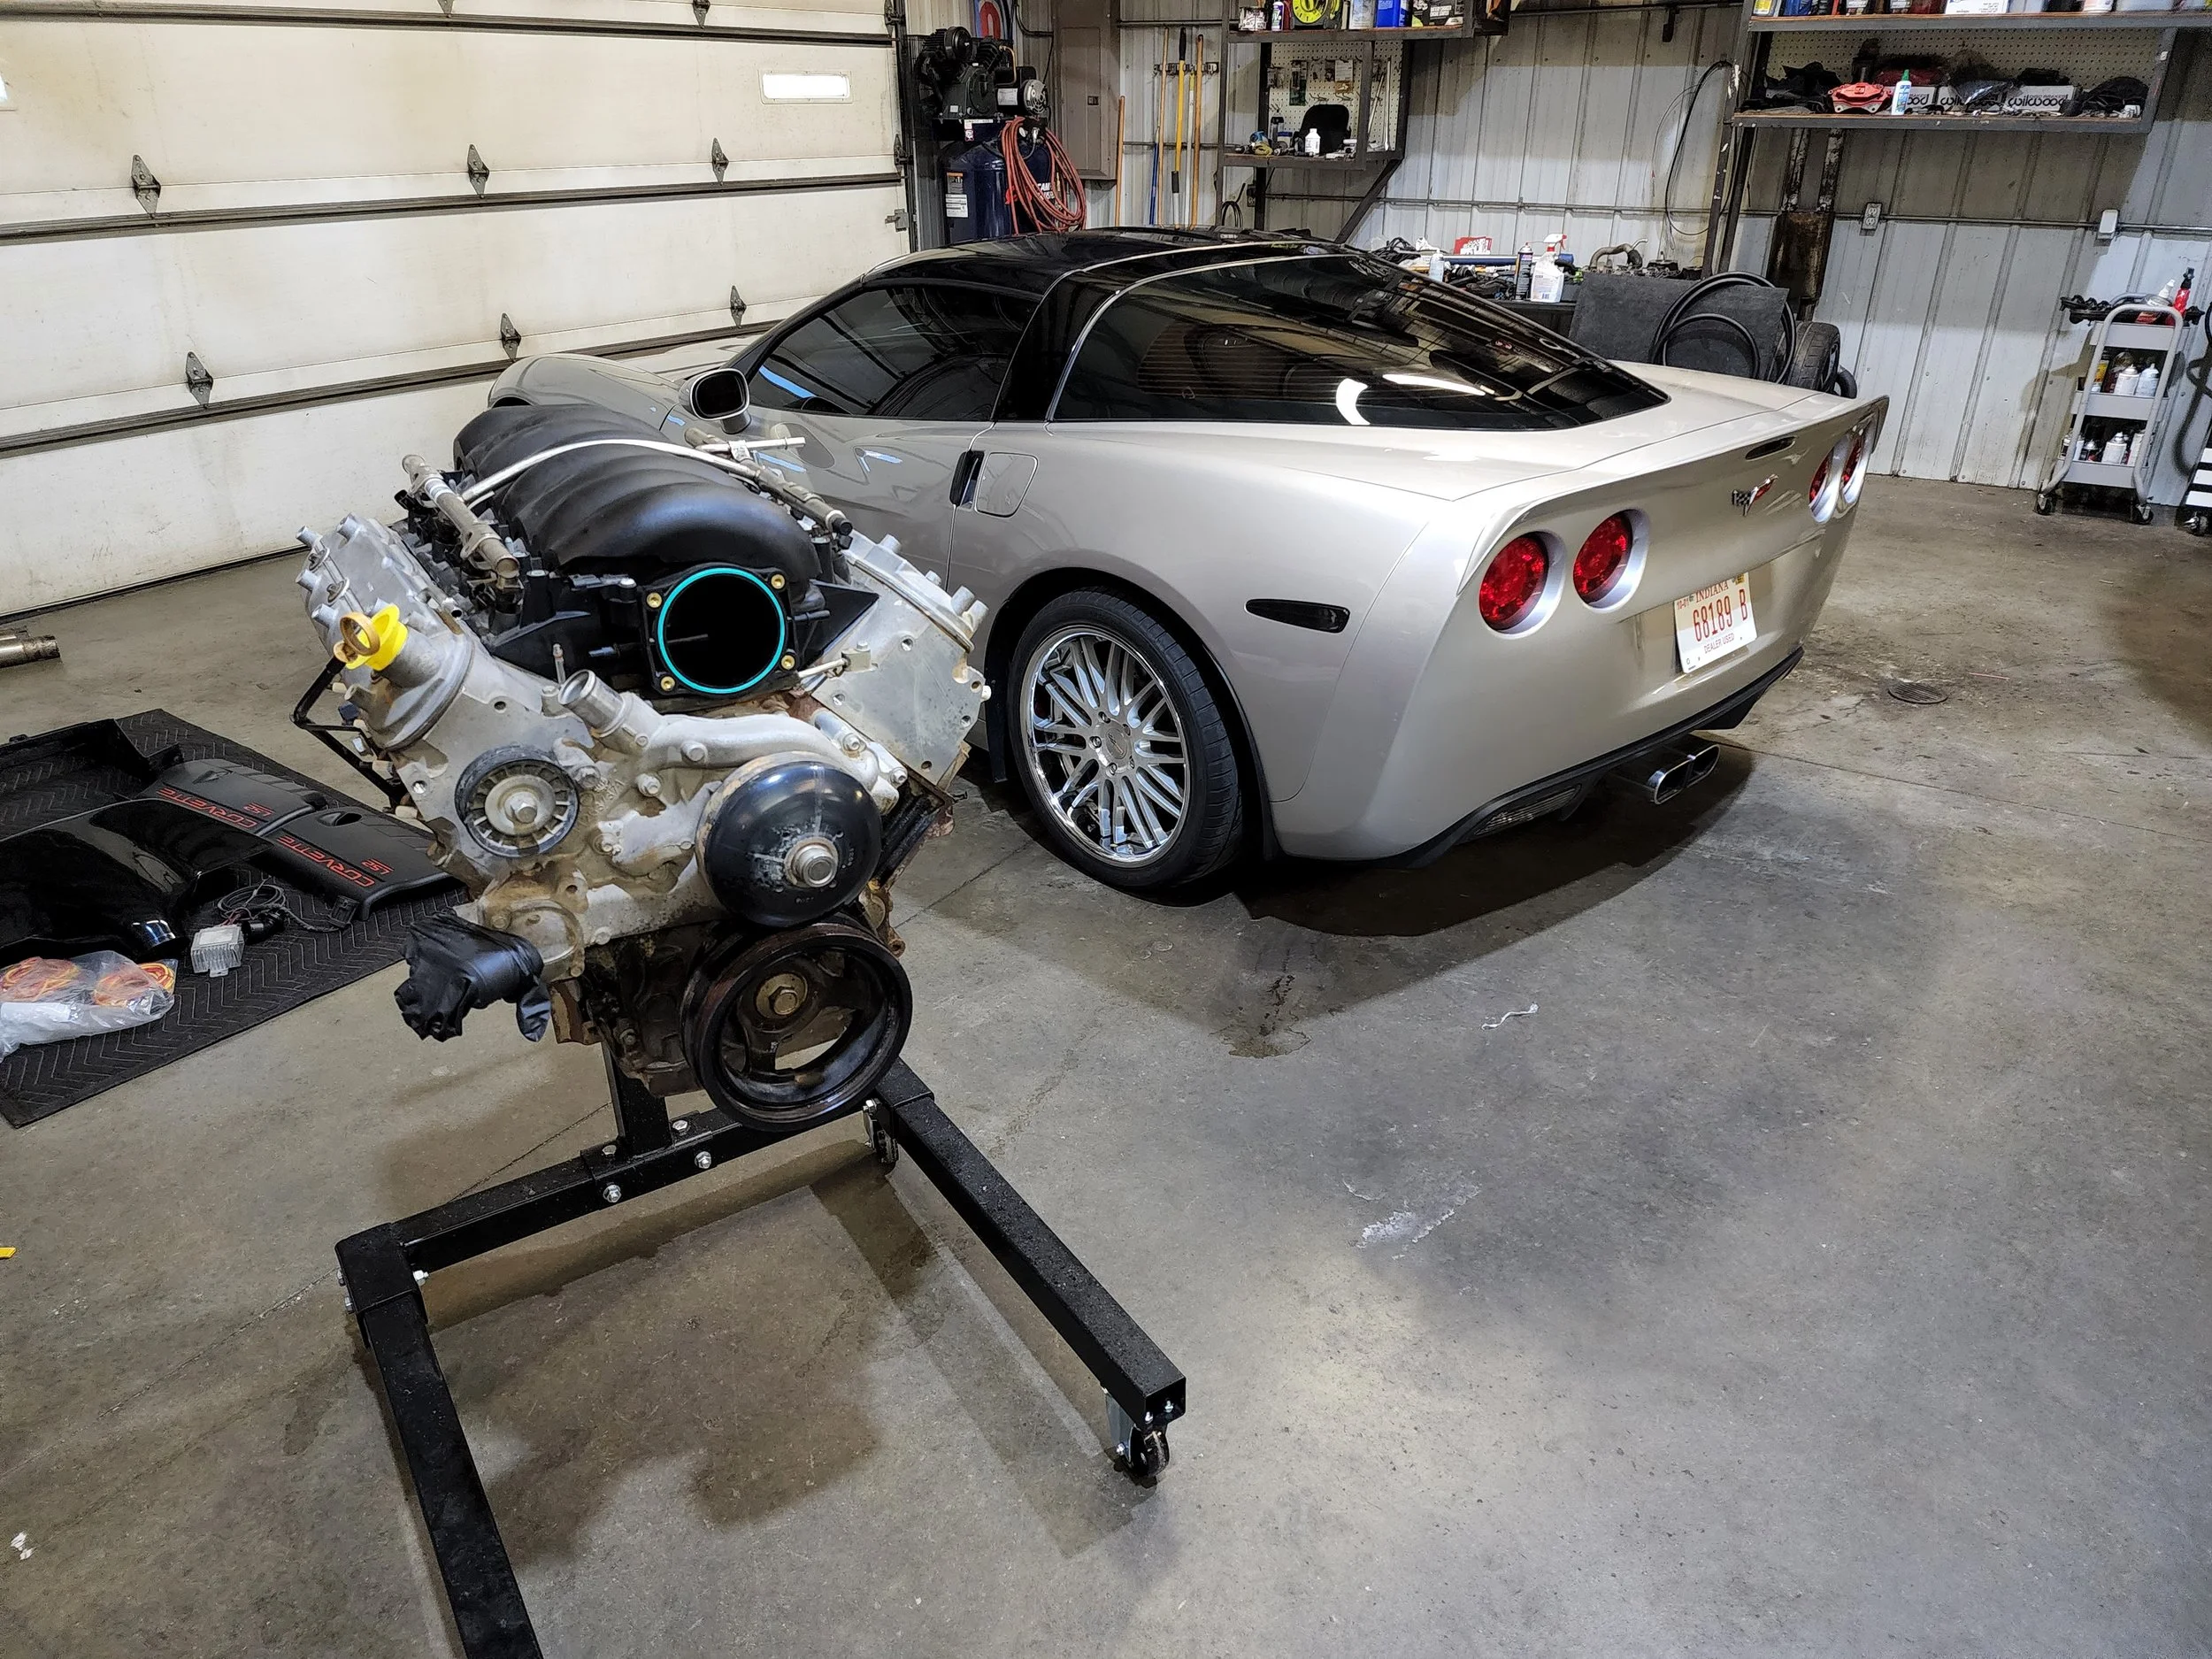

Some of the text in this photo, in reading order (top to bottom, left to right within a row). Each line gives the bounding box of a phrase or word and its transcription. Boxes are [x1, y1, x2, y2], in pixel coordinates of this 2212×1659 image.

[1695, 581, 1729, 603] INDIANA
[1693, 588, 1748, 641] 68189 B
[1704, 633, 1735, 654] DEALER USED
[157, 786, 257, 828] CORVETTE
[243, 803, 272, 818] LS2
[276, 834, 375, 887] CORVETTE
[360, 858, 393, 875] LS2
